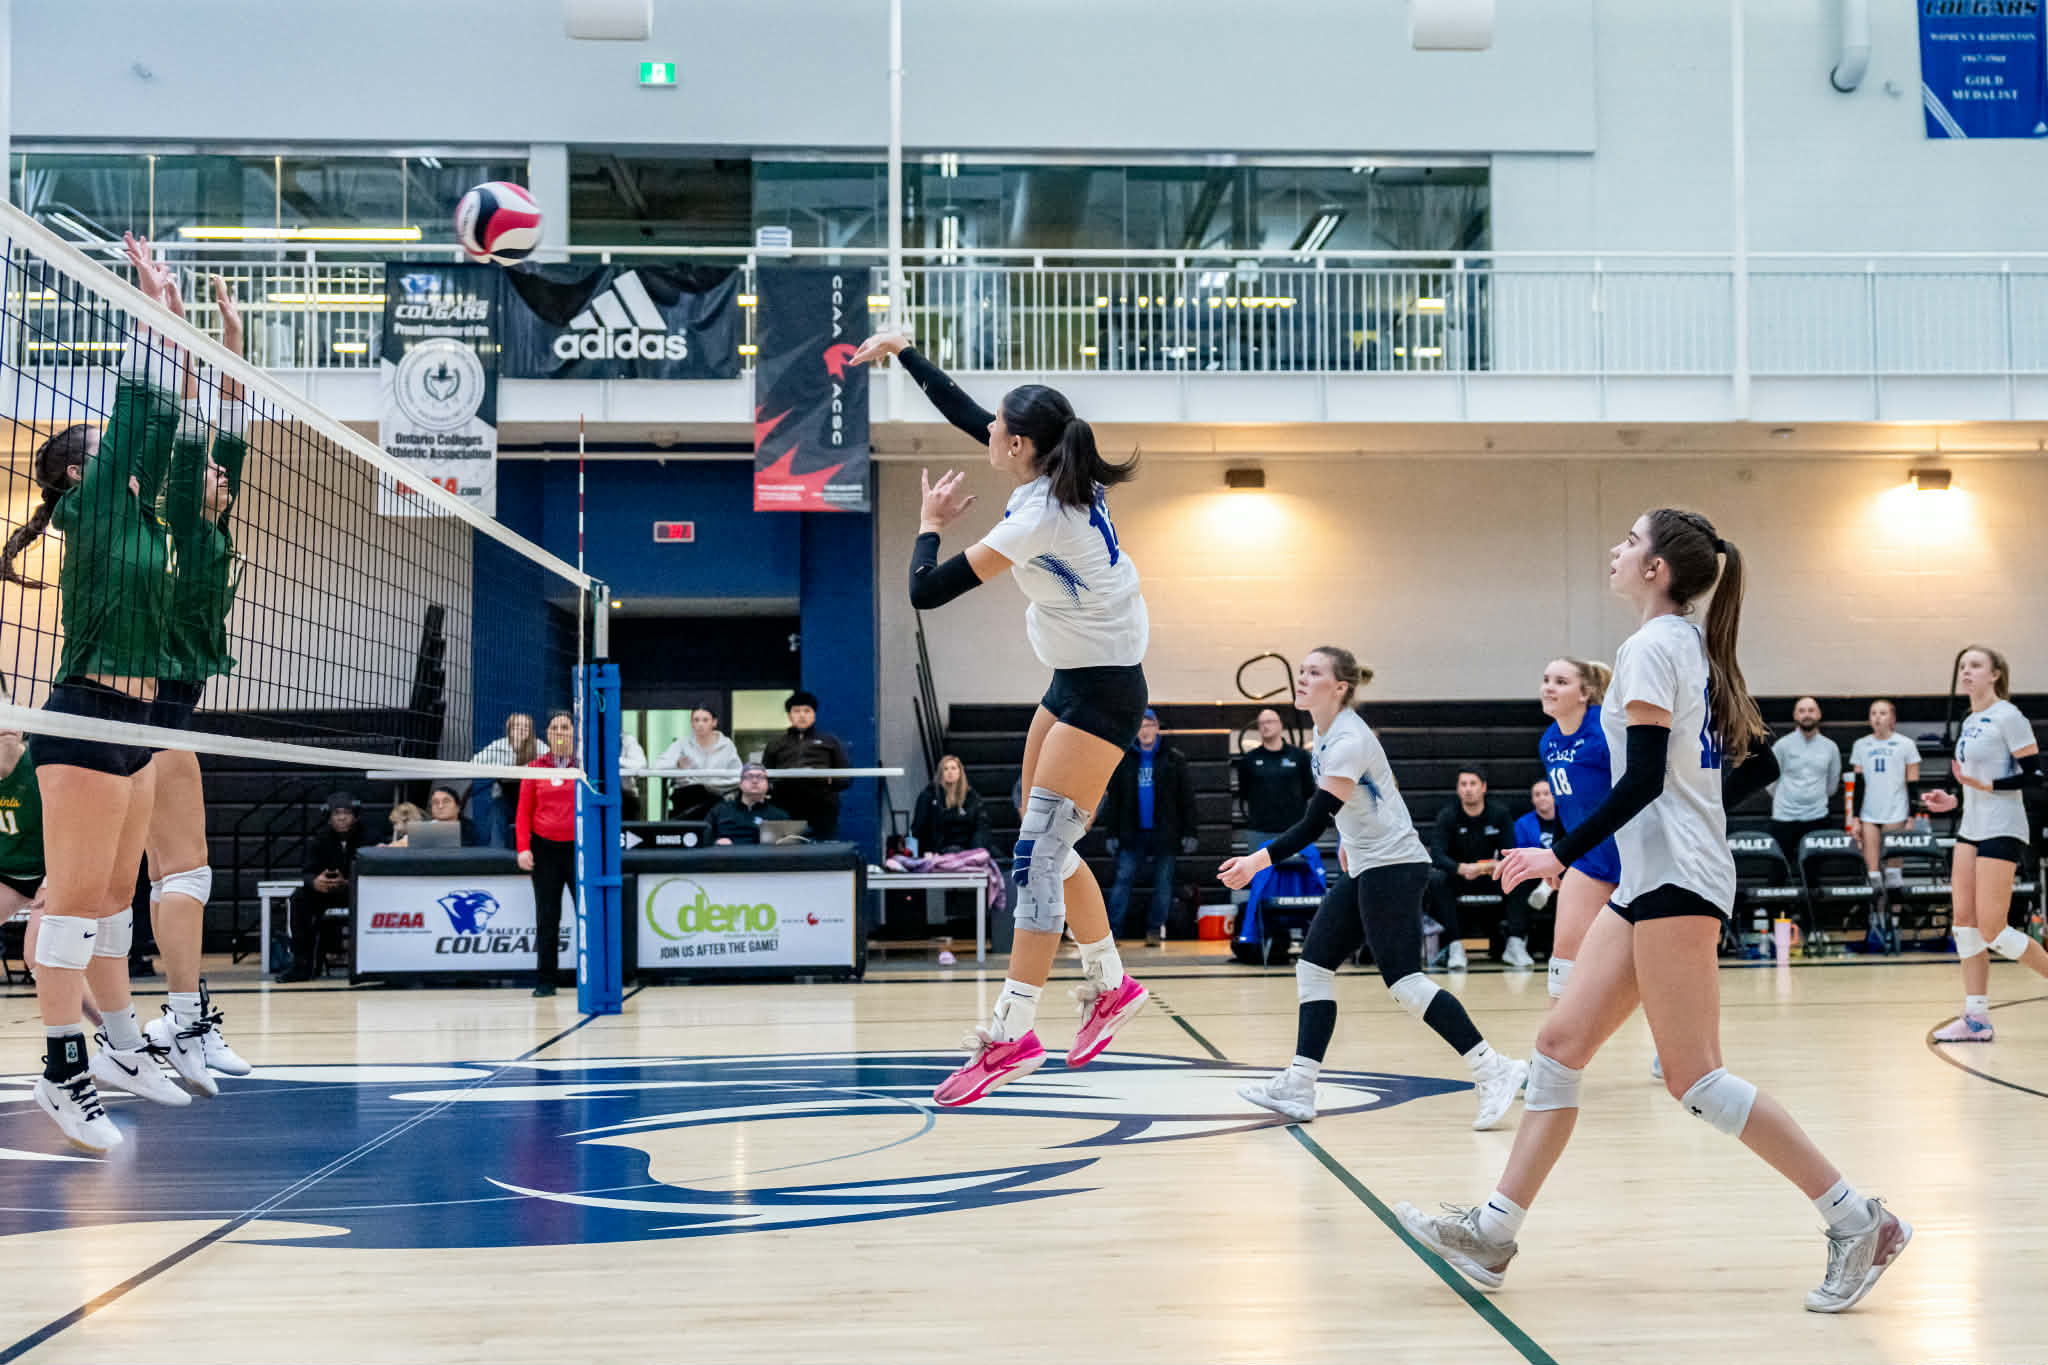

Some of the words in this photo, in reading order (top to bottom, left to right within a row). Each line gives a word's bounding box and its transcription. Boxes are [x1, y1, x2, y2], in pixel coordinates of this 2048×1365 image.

[1964, 75, 2004, 85] GOLD
[1952, 89, 2018, 100] MEDALIST
[394, 300, 489, 320] COUGARS
[831, 275, 843, 339] CCAA
[553, 326, 688, 360] adidas
[395, 433, 436, 445] Ontario
[437, 434, 483, 447] Colleges
[430, 448, 492, 460] Association
[1549, 767, 1573, 796] 18
[1727, 838, 1774, 851] SAULT
[1805, 836, 1852, 849] SAULT
[1884, 835, 1932, 847] SAULT
[371, 911, 425, 929] OCAA
[434, 934, 571, 955] COUGAS
[660, 946, 680, 959] JOIN
[682, 945, 695, 958] US
[696, 942, 726, 957] AFTER
[728, 941, 746, 954] THE
[748, 939, 779, 953] GAME!
